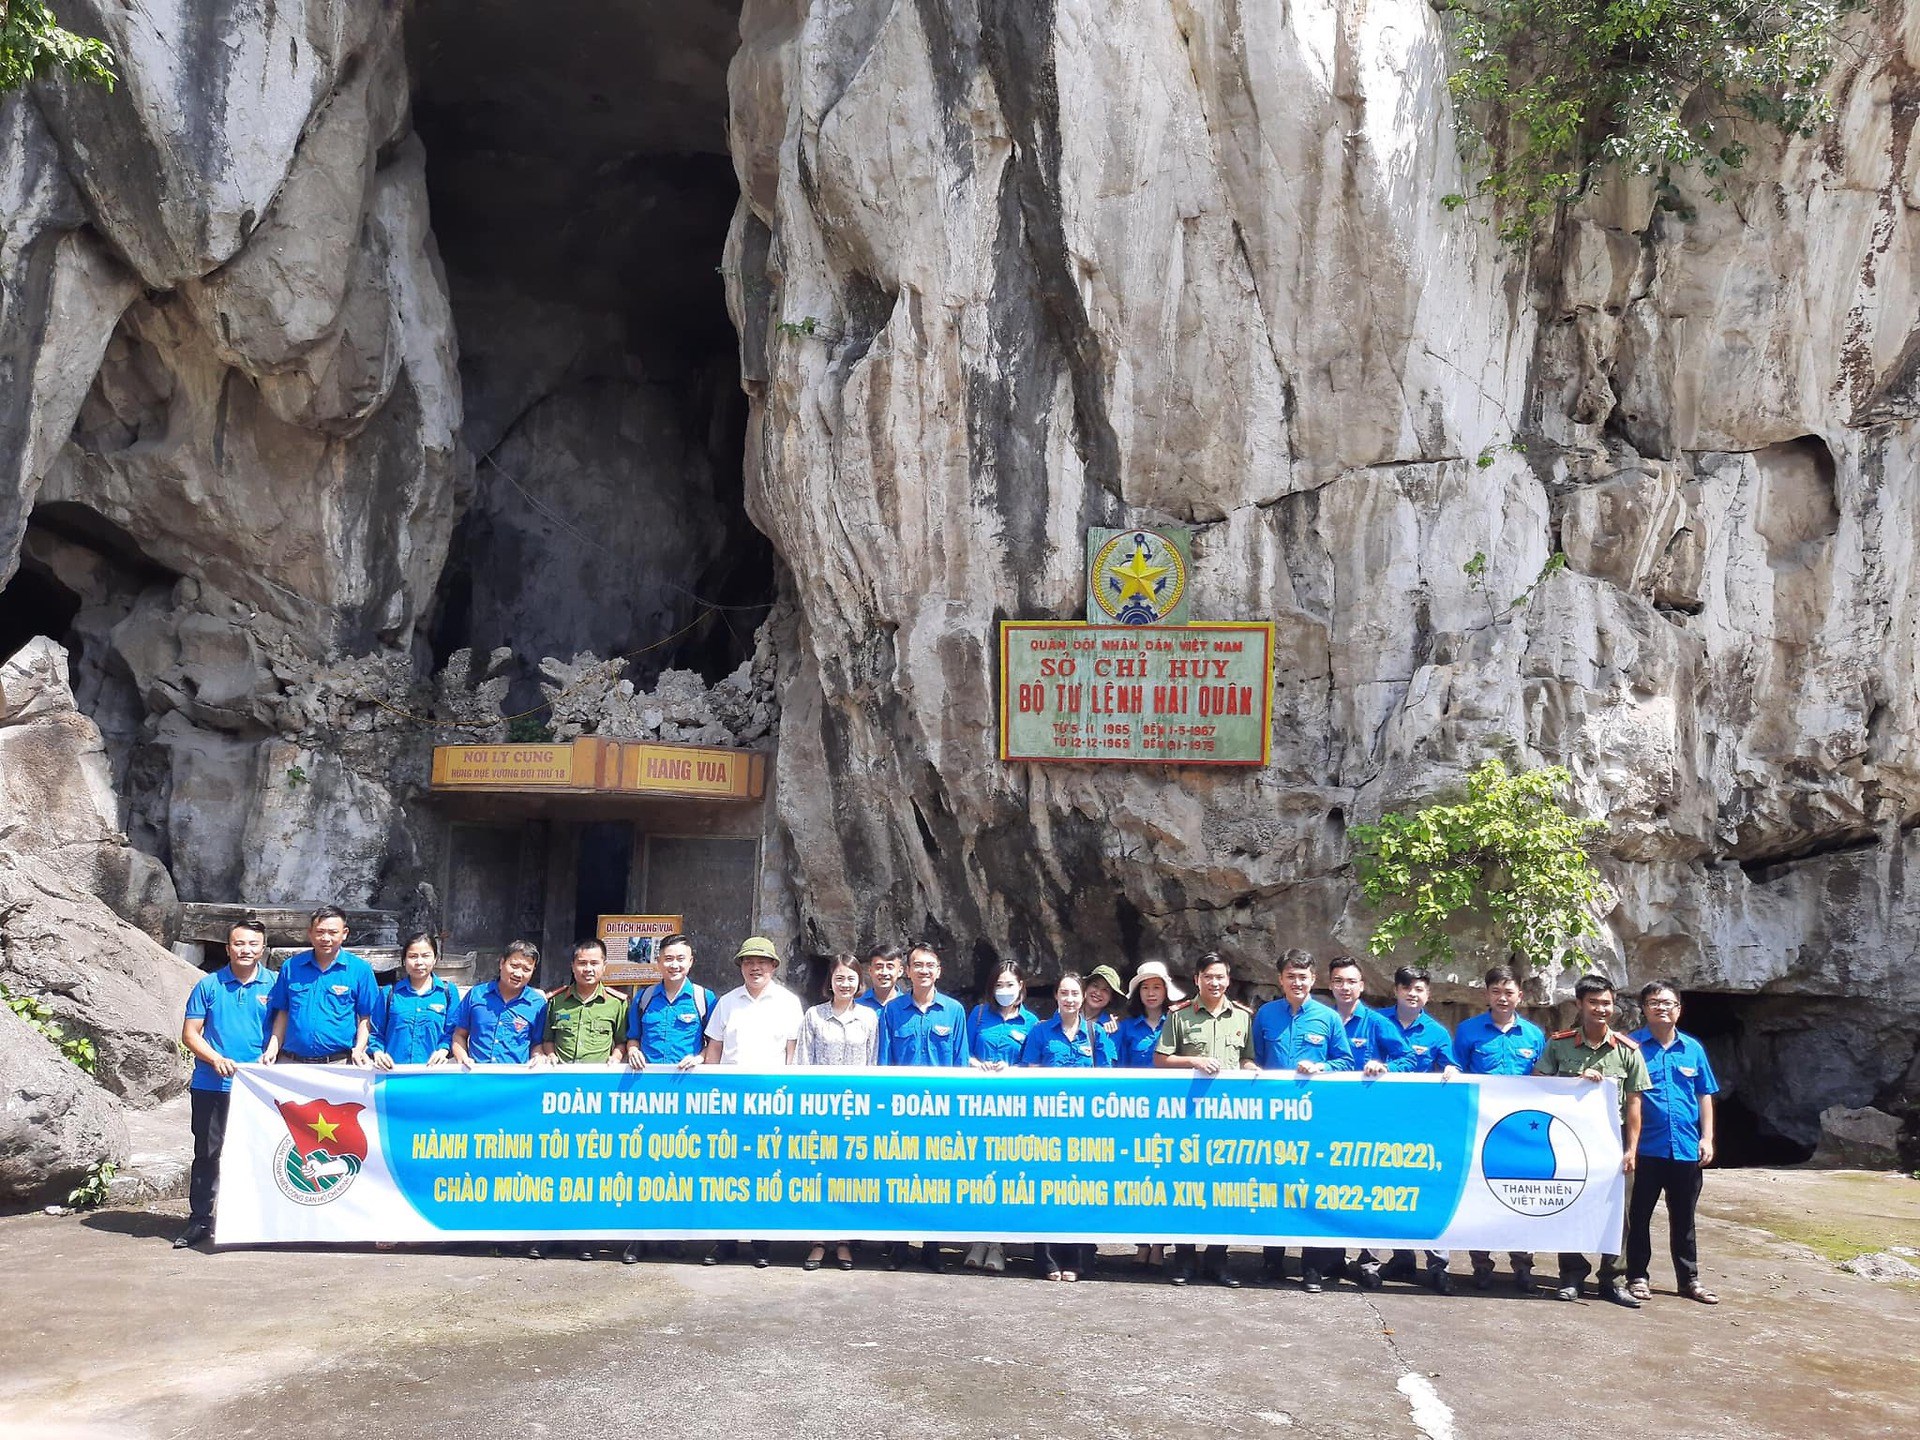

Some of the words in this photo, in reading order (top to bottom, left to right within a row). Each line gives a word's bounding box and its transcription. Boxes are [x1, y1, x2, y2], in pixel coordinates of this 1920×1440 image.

[1030, 637, 1067, 651] QUÂN
[1102, 637, 1139, 651] NHÂN
[1179, 637, 1208, 653] VIỆT
[1213, 640, 1244, 653] NAM
[1040, 651, 1077, 677] SỞ
[1094, 651, 1148, 678] CHỈ
[1168, 658, 1230, 679] HUY
[1019, 680, 1045, 716] BỘ
[1055, 683, 1082, 713] TƯ
[1091, 681, 1143, 717] LỆNH
[1153, 679, 1188, 715] HẢI
[1199, 682, 1253, 717] QUÂN
[493, 751, 509, 763] LY
[647, 757, 692, 780] HANG
[697, 761, 727, 782] VUA
[617, 920, 634, 933] TÍCH
[635, 923, 657, 933] HANG
[659, 923, 674, 933] VUA
[542, 1087, 602, 1115] ĐOÀN
[608, 1091, 679, 1115] THANH
[685, 1088, 737, 1115] NIÊN
[743, 1085, 795, 1116] KHỐI
[799, 1089, 870, 1121] HUYỆN
[891, 1089, 951, 1117] ĐOÀN
[957, 1094, 1027, 1118] THANH
[1033, 1091, 1085, 1118] NIÊN
[1091, 1092, 1150, 1119] CÔNG
[1156, 1096, 1187, 1119] AN
[1192, 1093, 1264, 1121] THÀNH
[1269, 1091, 1313, 1122] PHỐ
[411, 1128, 469, 1159] HÀNH
[473, 1128, 533, 1159] TRÌNH
[538, 1128, 570, 1159] TÔI
[575, 1128, 613, 1159] YÊU
[618, 1123, 645, 1159] TỔ
[648, 1124, 702, 1162] QUỐC
[707, 1128, 738, 1159] TÔI
[757, 1126, 783, 1159] KỶ
[788, 1129, 839, 1165] KIỆM
[843, 1135, 868, 1160] 75
[873, 1129, 920, 1160] NĂM
[925, 1130, 979, 1161] NGÀY
[983, 1133, 1062, 1162] THƯƠNG
[1067, 1137, 1115, 1163] BINH
[1134, 1132, 1175, 1169] LIỆT
[1179, 1133, 1200, 1164] SĨ
[1206, 1139, 1310, 1167] (27/7/1947
[1329, 1141, 1442, 1171] 27/7/2022),
[434, 1172, 488, 1203] CHÀO
[493, 1171, 554, 1203] MỪNG
[599, 1171, 633, 1208] HỘI
[638, 1171, 693, 1203] ĐOÀN
[699, 1176, 751, 1203] TNCS
[756, 1168, 783, 1203] HỒ
[788, 1172, 823, 1203] CHÍ
[827, 1178, 881, 1204] MINH
[886, 1173, 951, 1204] THÀNH
[956, 1170, 998, 1205] PHỐ
[1002, 1172, 1035, 1206] HẢI
[1040, 1174, 1109, 1206] PHÒNG
[1114, 1175, 1167, 1207] KHÓA
[1172, 1180, 1207, 1210] XIV,
[1212, 1177, 1278, 1213] NHIỆM
[1283, 1178, 1309, 1209] KỲ
[1315, 1185, 1420, 1212] 2022-2027
[1502, 1184, 1541, 1194] THANH
[1544, 1183, 1573, 1195] NIÊN
[1539, 1197, 1565, 1206] NAM
